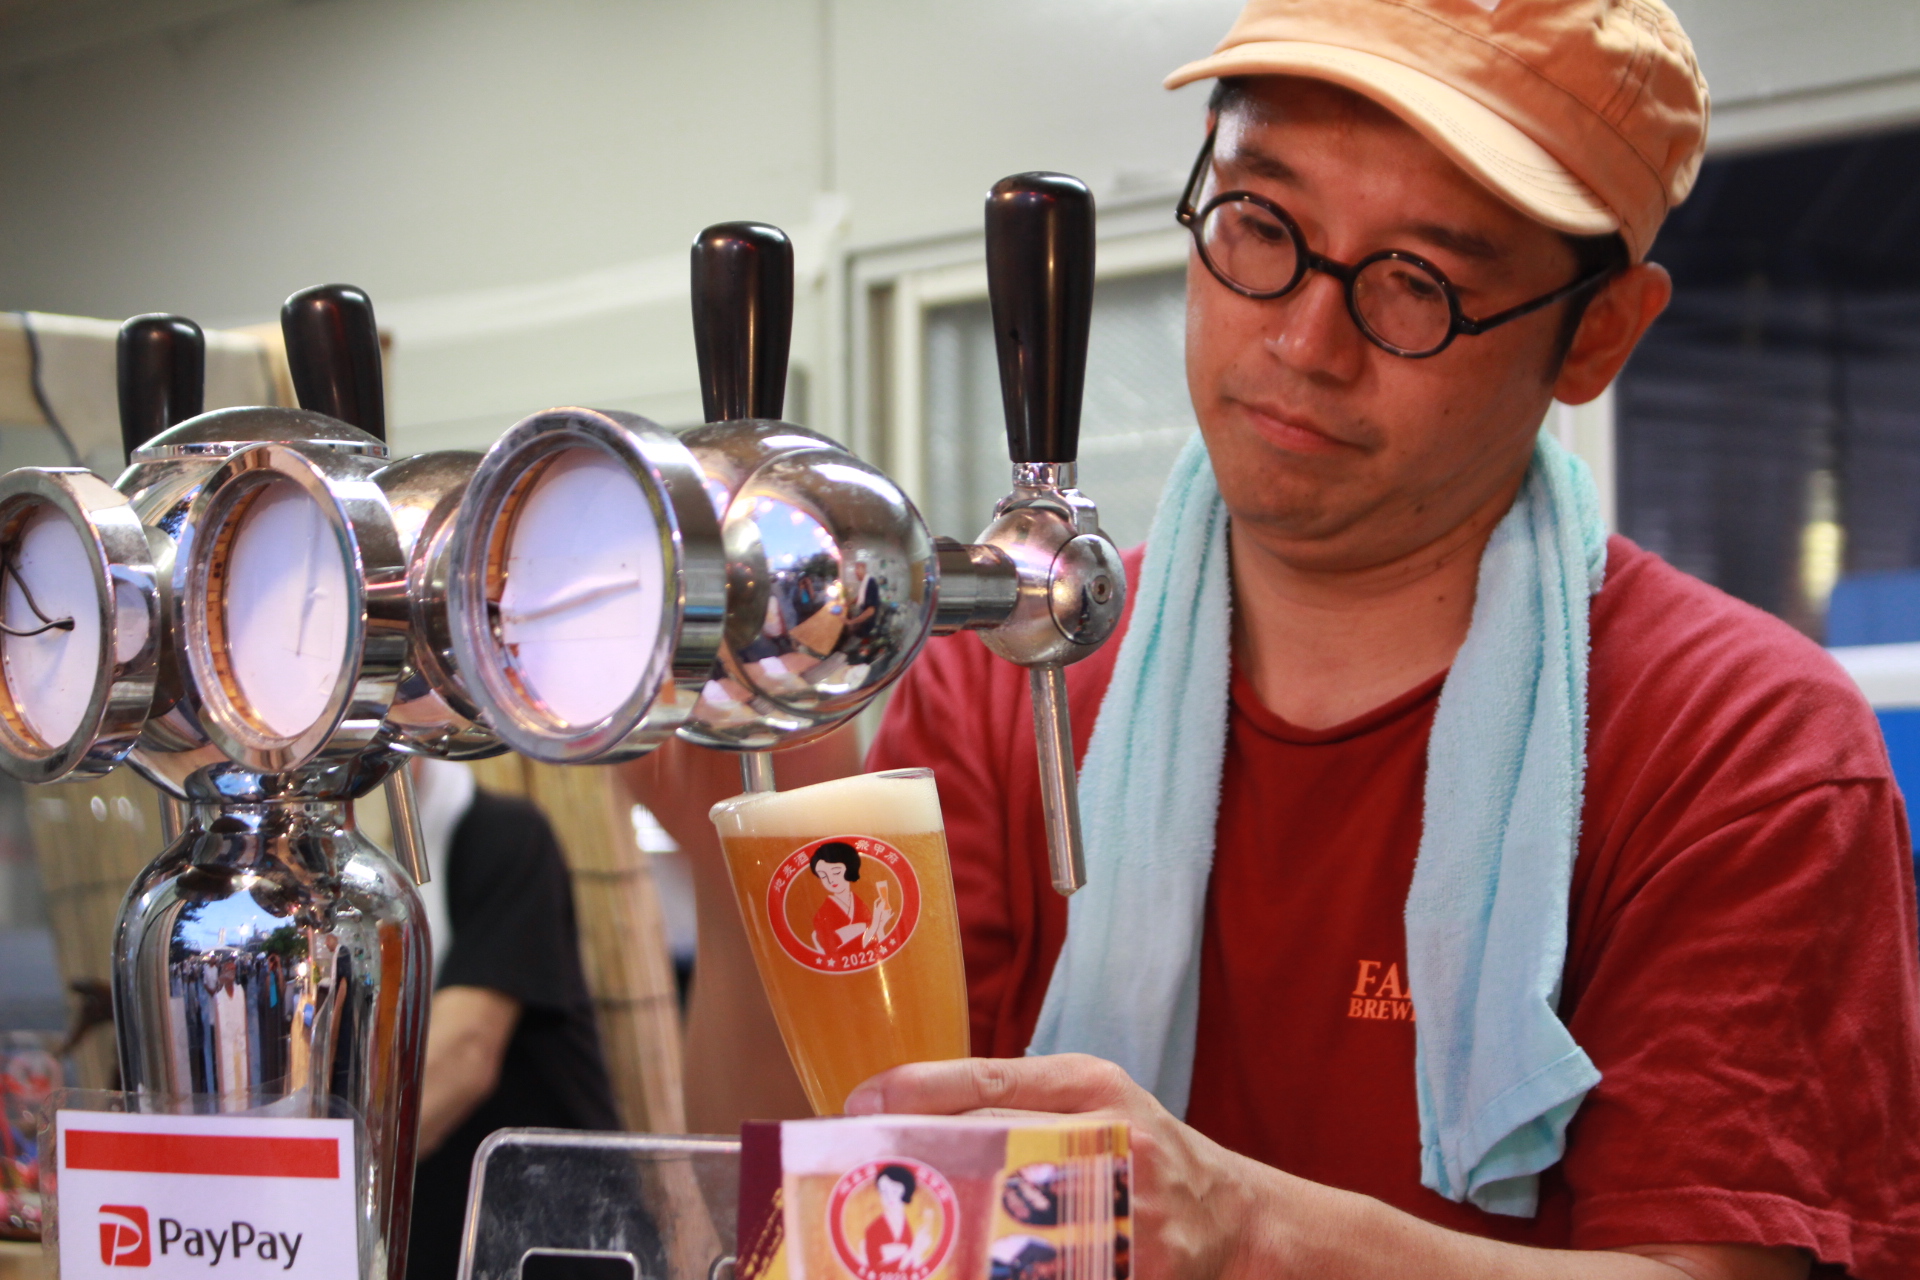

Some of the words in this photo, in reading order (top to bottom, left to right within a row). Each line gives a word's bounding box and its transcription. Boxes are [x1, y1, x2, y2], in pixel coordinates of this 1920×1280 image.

[841, 949, 876, 969] 2022
[1352, 959, 1412, 999] FA
[159, 1217, 303, 1270] PayPay
